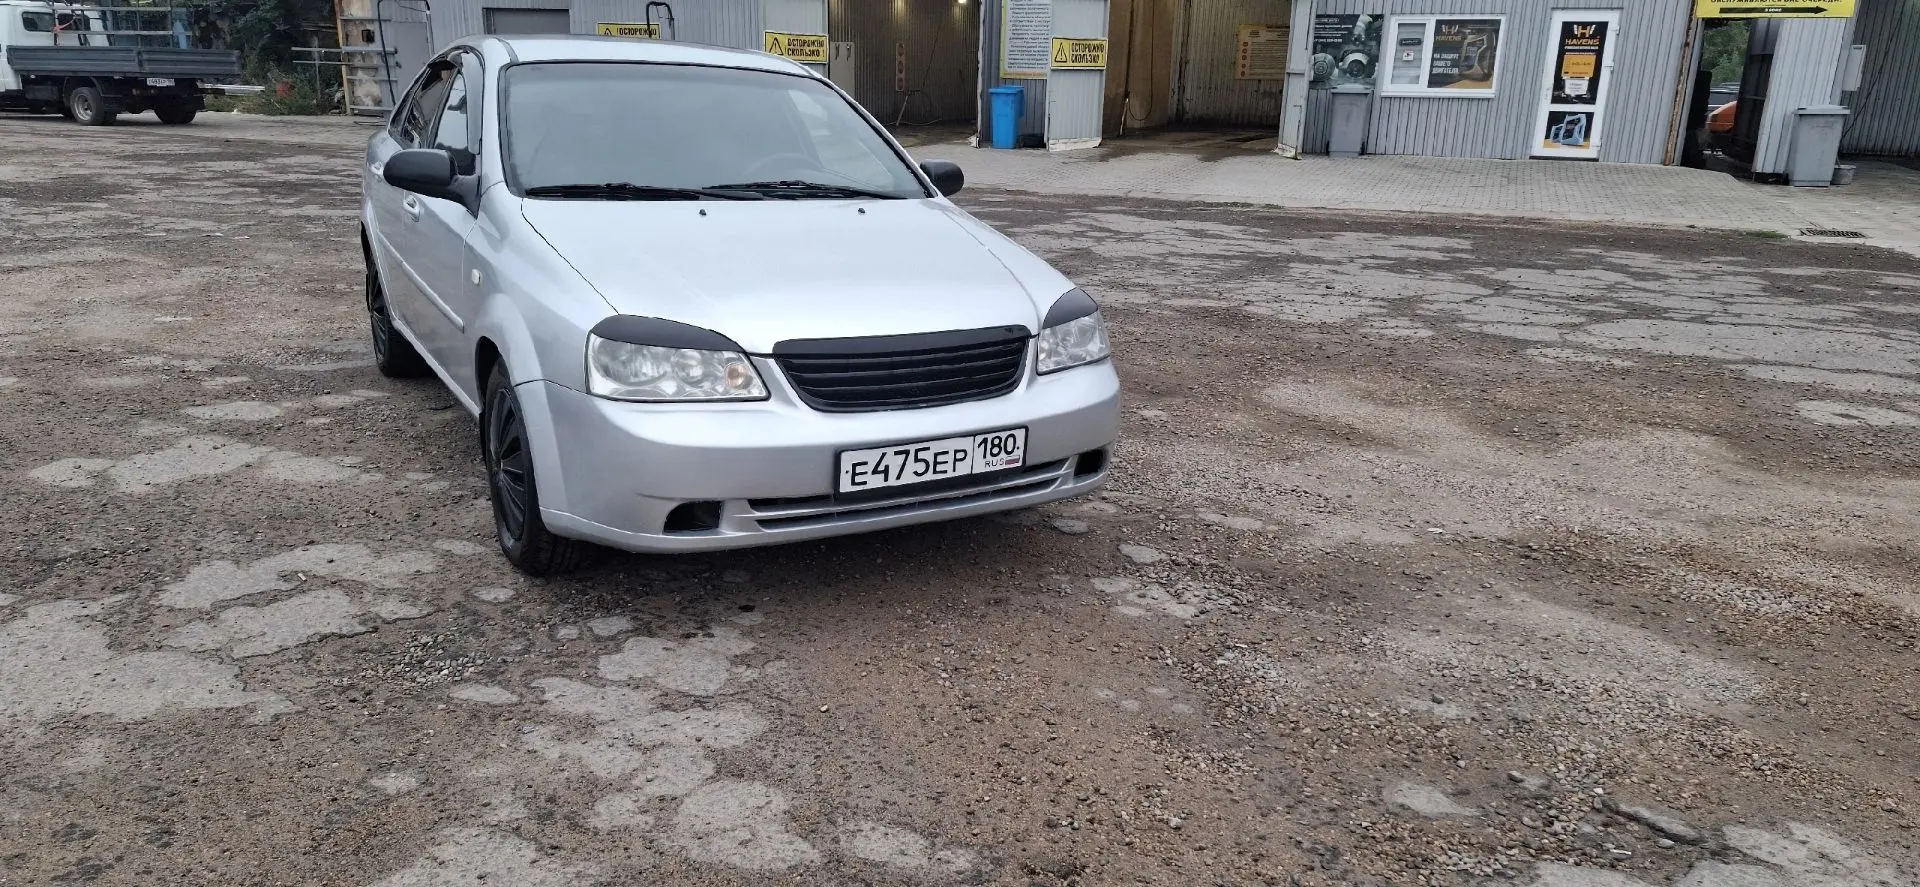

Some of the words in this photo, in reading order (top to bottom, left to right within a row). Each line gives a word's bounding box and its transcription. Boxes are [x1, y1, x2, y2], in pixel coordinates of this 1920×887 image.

[787, 38, 825, 48] ОСТОРОЖНО
[1071, 42, 1105, 53] ОСТОРОЖНО
[787, 48, 820, 57] СКОЛЬЗКО
[1071, 54, 1100, 63] СКОЛЬЗКО
[977, 433, 1017, 459] 180
[984, 459, 1004, 468] RUS
